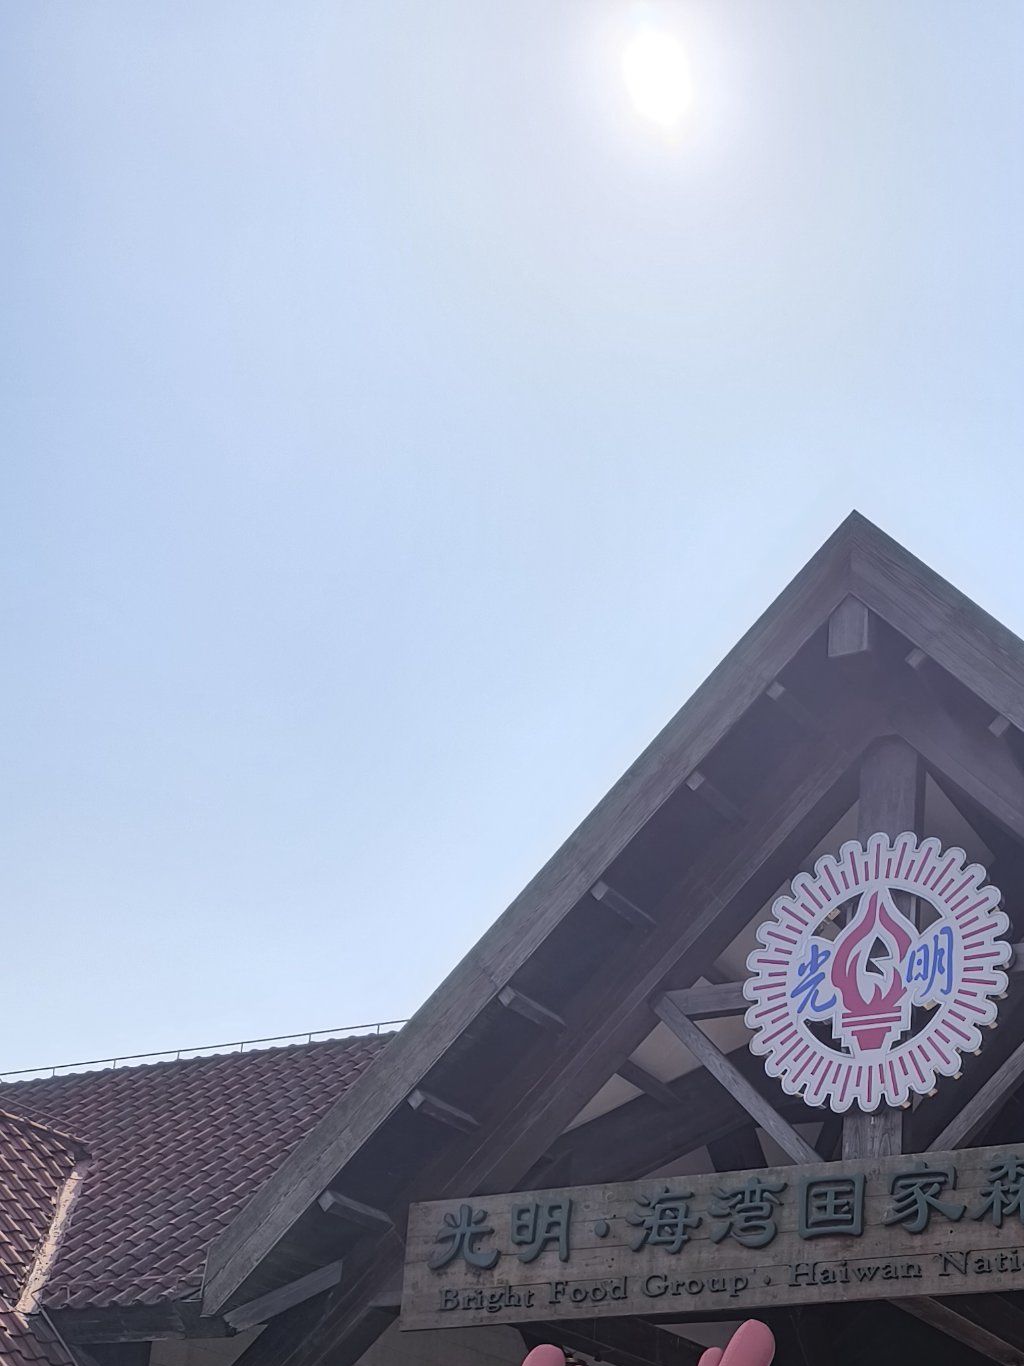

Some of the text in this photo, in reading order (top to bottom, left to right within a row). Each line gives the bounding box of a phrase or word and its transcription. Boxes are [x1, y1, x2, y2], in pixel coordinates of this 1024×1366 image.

[439, 1284, 536, 1313] Bright
[548, 1275, 627, 1304] Food
[787, 1261, 922, 1288] Haiwan
